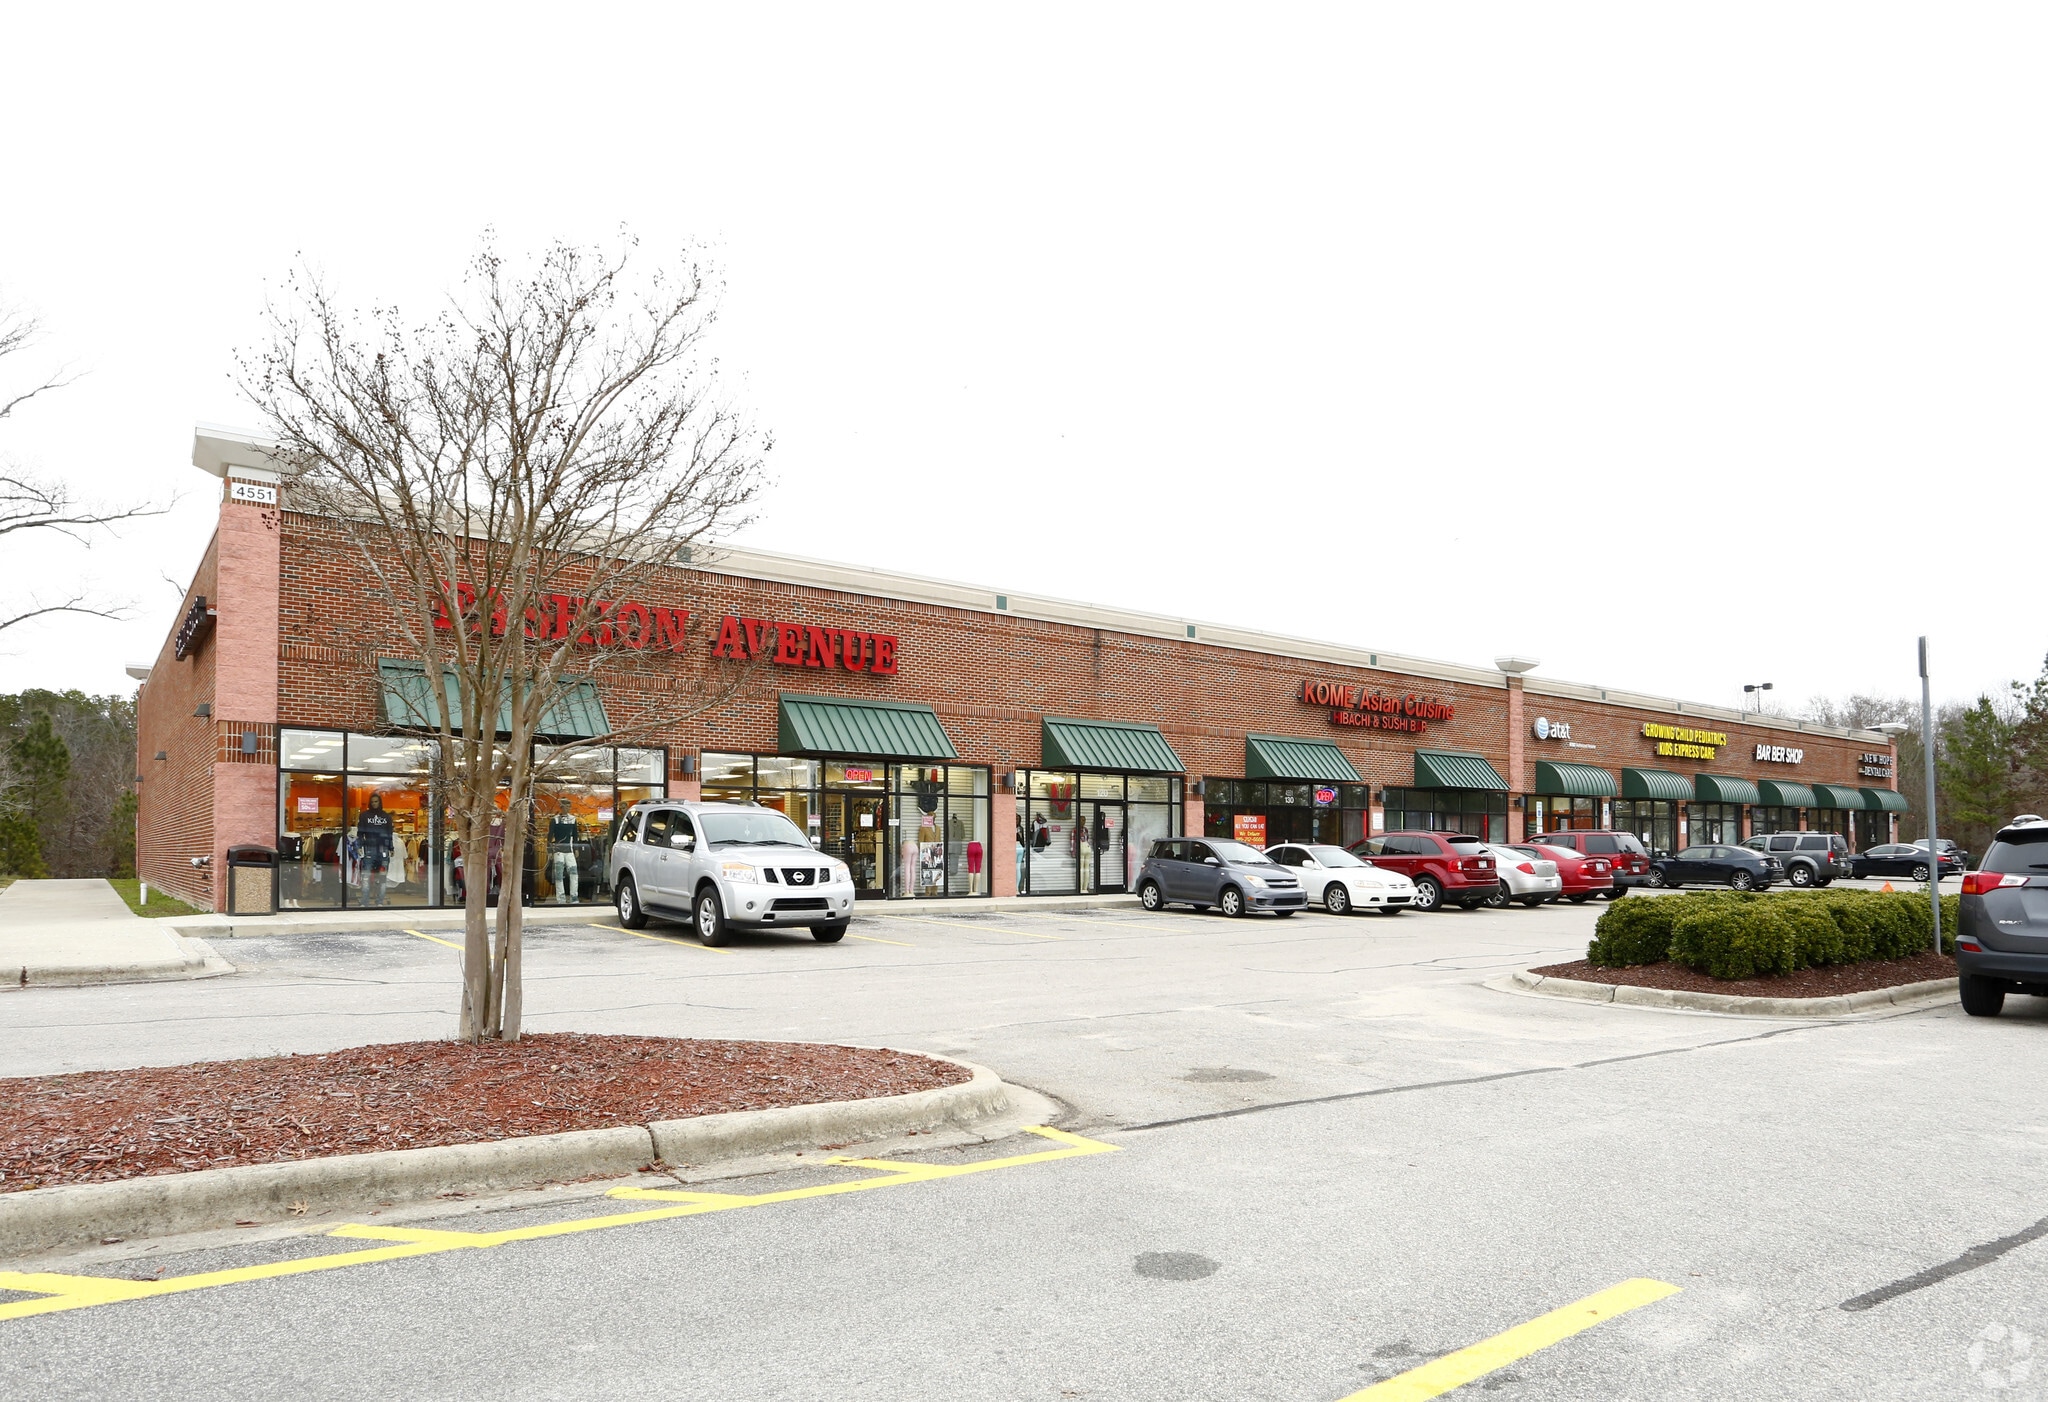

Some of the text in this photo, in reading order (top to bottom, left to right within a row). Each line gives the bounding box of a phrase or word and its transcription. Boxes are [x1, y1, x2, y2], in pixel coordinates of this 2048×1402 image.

[236, 486, 272, 501] 4551
[712, 615, 898, 675] AVENUE
[1303, 680, 1455, 721] KOME Asian Cuisine
[1333, 711, 1427, 733] HIBACHI & SUSHI BAR
[1645, 723, 1727, 746] GROWING CHILD PEDIATRICS
[1659, 742, 1715, 760] KIDS EXPRESS CARE
[1785, 747, 1803, 764] SHOP
[845, 769, 872, 782] OPEN
[1285, 796, 1295, 804] 130
